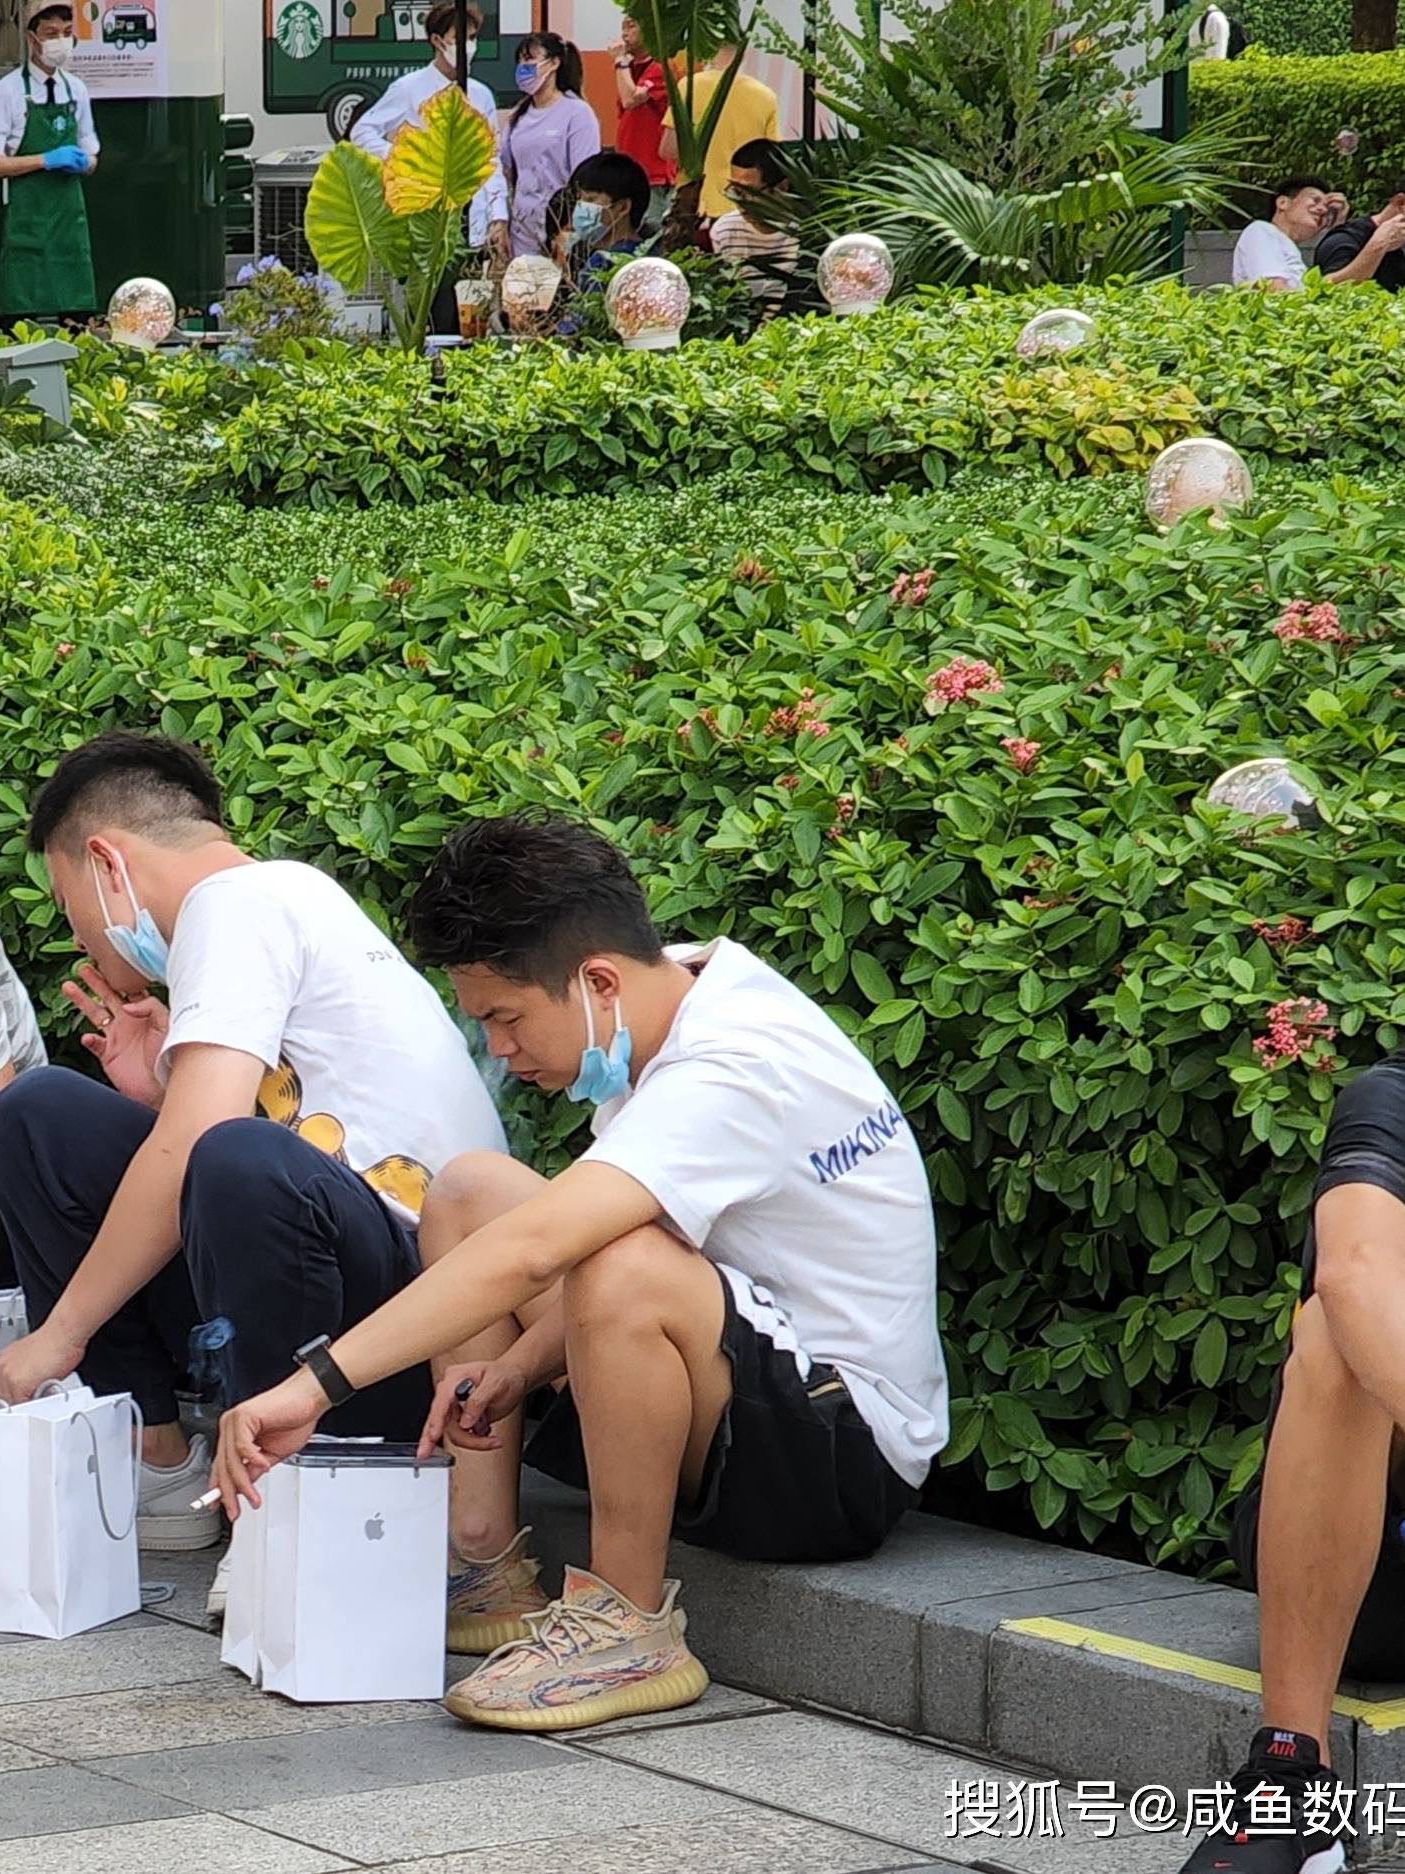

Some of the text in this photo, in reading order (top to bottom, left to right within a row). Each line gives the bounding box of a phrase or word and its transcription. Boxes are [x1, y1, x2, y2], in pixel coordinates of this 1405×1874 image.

[809, 1099, 903, 1184] MIKINA
[1273, 1730, 1296, 1744] MAX
[1266, 1741, 1298, 1758] AIR
